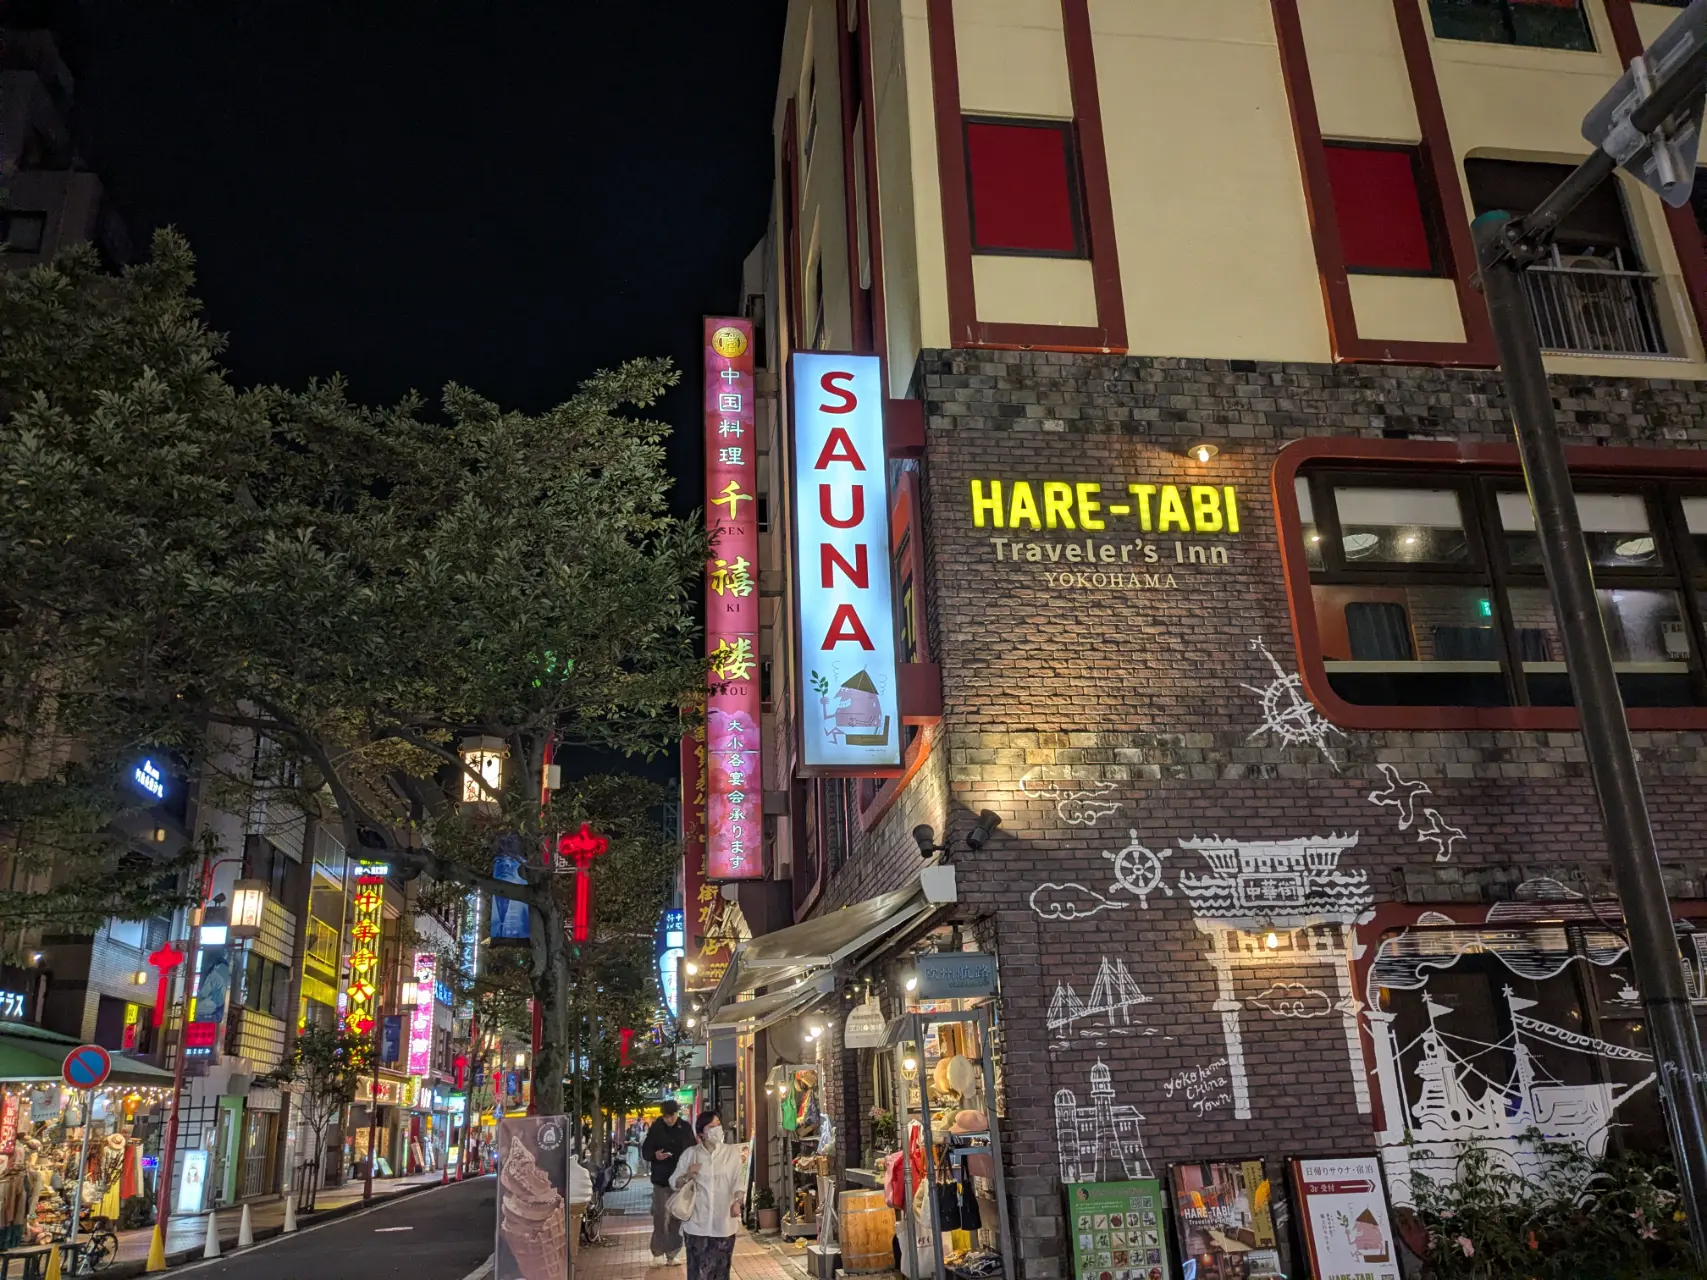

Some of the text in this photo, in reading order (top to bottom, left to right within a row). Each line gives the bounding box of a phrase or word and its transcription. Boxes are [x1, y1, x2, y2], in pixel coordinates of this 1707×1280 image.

[717, 367, 746, 467] 中国料理
[814, 371, 876, 651] SAUNA
[970, 479, 1240, 533] HARE-TABI
[990, 537, 1229, 565] Traveler's Inn
[1044, 572, 1179, 589] YOKOHAMA
[726, 603, 740, 612] KI
[727, 719, 746, 870] 大小各宴会承ります
[1246, 879, 1297, 901] 中華街
[1305, 1164, 1374, 1177] 日帰りサウナ・宿泊
[1320, 1184, 1336, 1193] 受付
[1184, 1206, 1232, 1220] HARE-TABI
